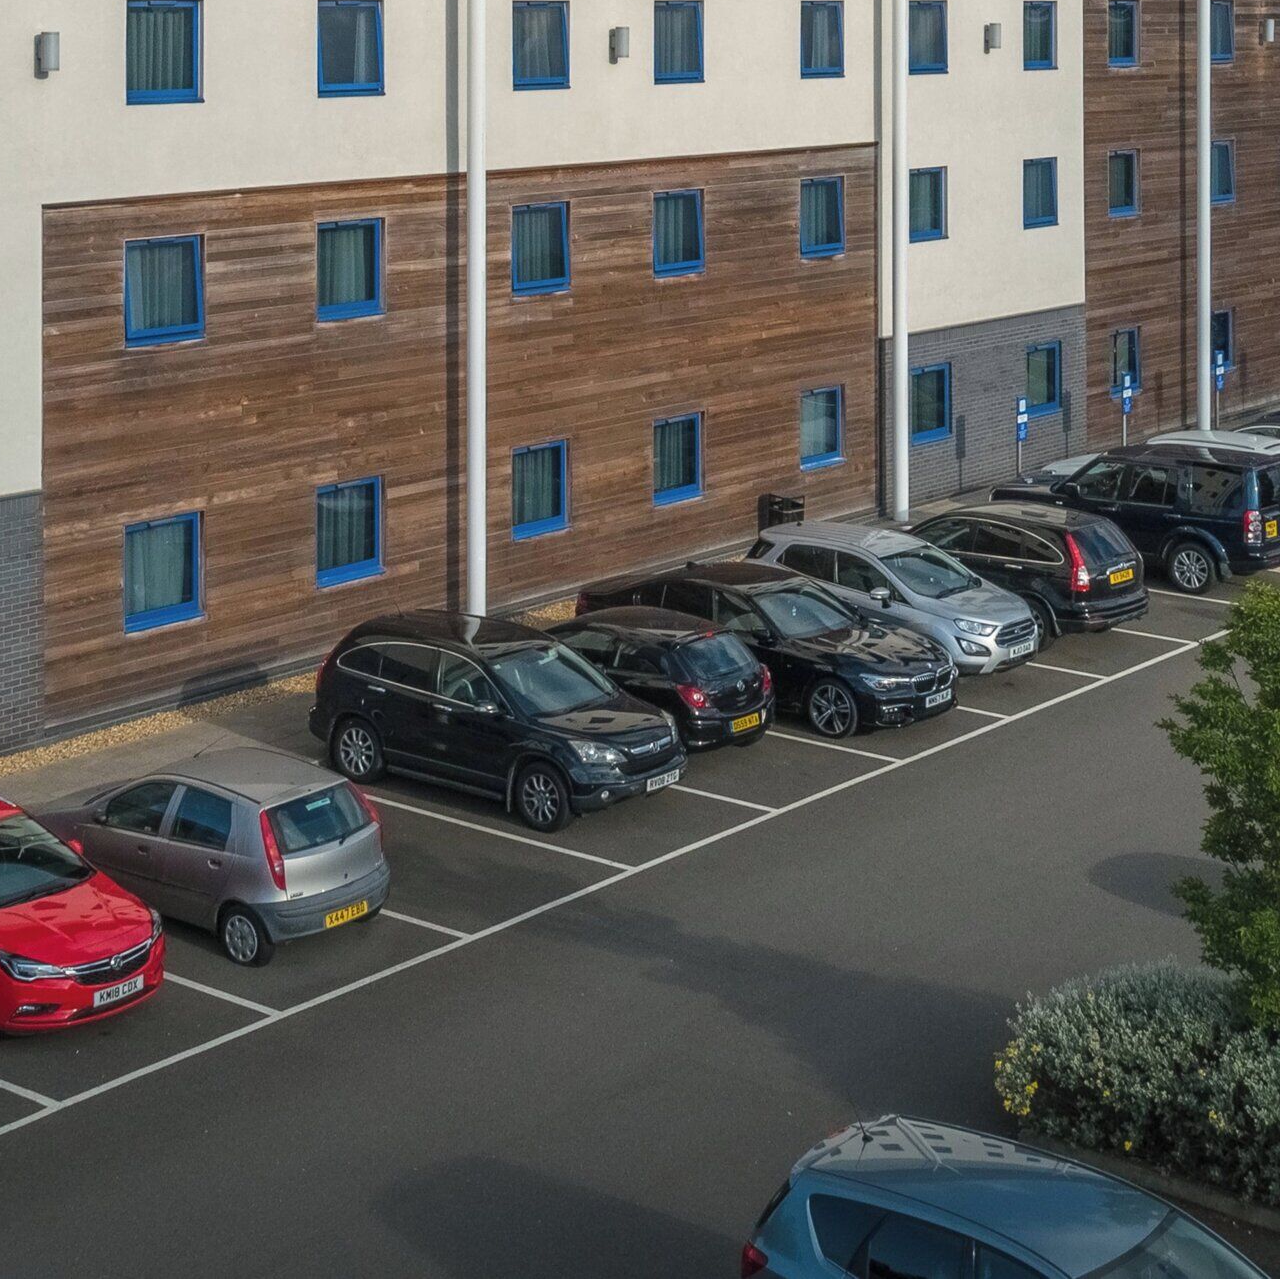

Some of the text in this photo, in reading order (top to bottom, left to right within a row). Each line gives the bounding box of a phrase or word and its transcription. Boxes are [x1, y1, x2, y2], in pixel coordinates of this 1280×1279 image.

[328, 908, 349, 926] X447
[100, 979, 138, 1002] KM18 CDX
